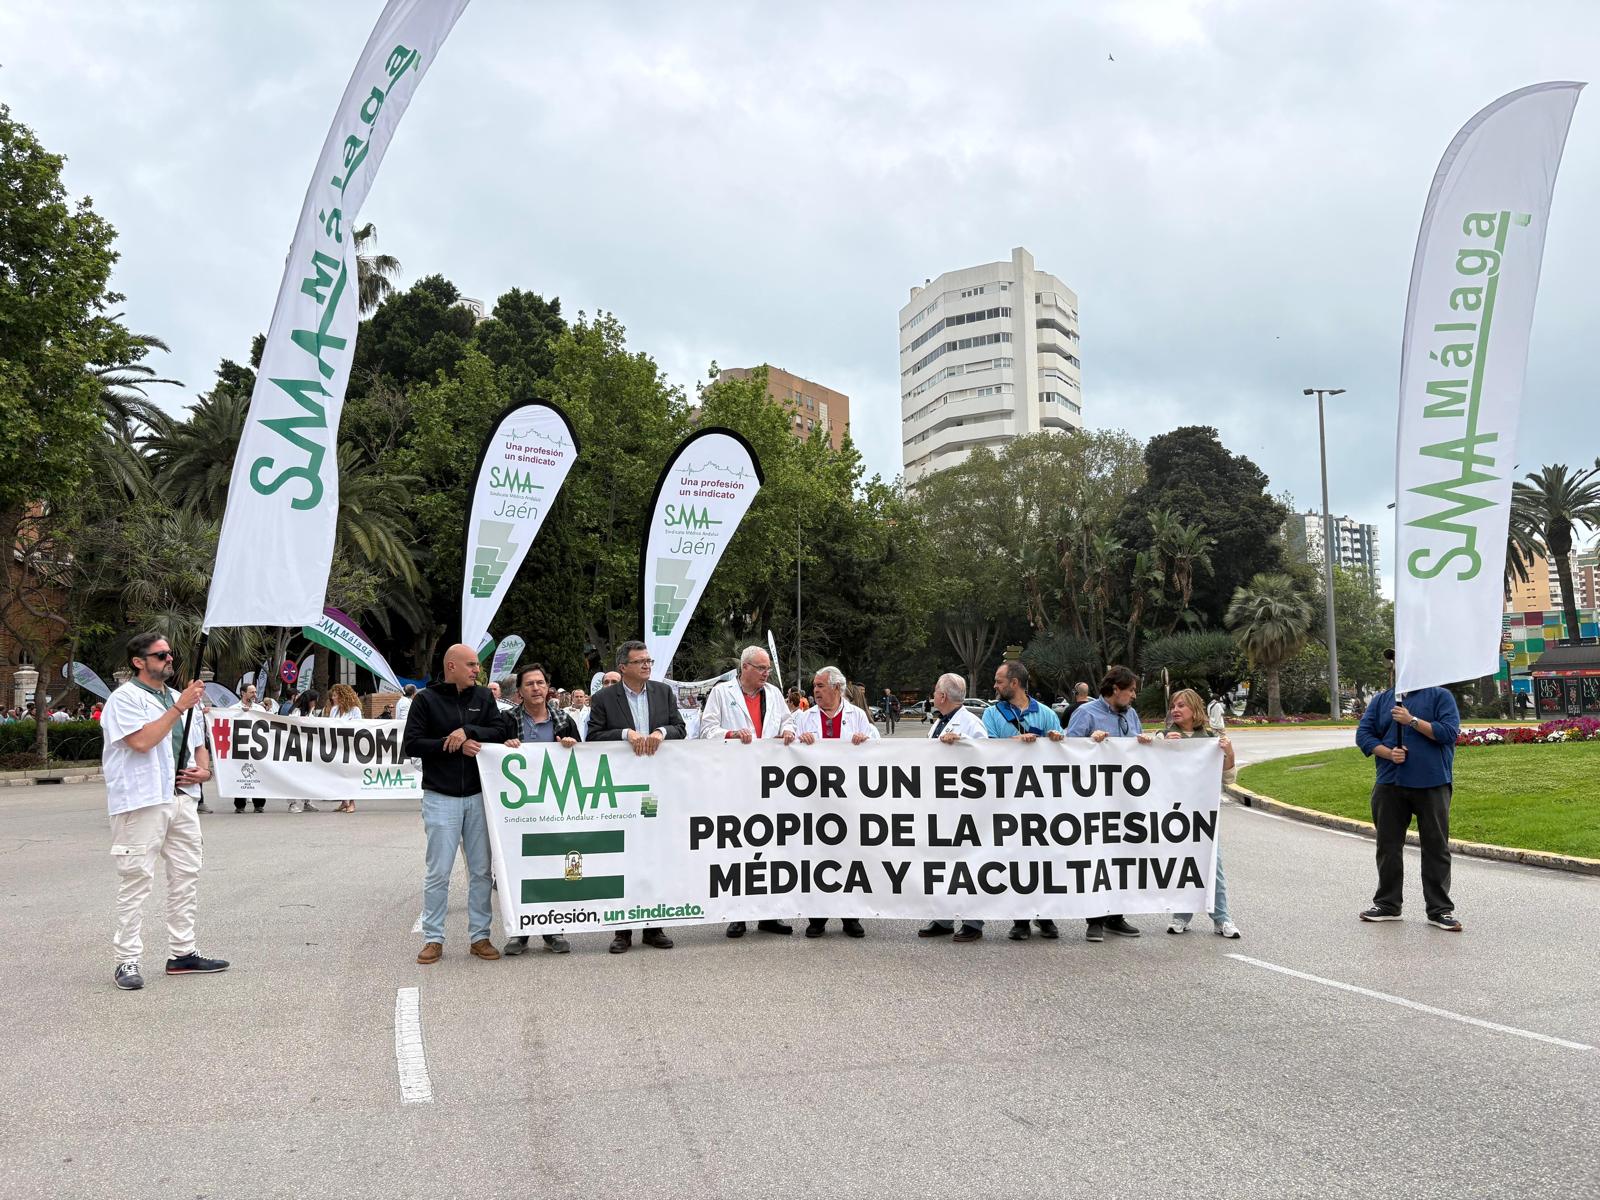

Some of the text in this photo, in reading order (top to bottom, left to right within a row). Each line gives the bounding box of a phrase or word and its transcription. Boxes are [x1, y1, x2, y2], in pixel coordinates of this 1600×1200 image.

[1403, 212, 1502, 581] SMA Málaga
[250, 329, 347, 511] SMA
[504, 453, 556, 467] un sindicato
[505, 442, 564, 458] Una profesión
[489, 466, 544, 494] SMA
[680, 477, 744, 490] Una profesión
[693, 489, 736, 500] sindicato
[493, 500, 538, 520] Jaén
[664, 503, 723, 530] SMA
[670, 537, 716, 555] Jaén
[363, 768, 414, 788] SMA
[500, 747, 650, 816] SMA
[761, 764, 1150, 799] POR UN ESTATUTO
[504, 815, 537, 823] Sindicato
[539, 814, 565, 823] Médico
[566, 814, 594, 822] Andaluz
[601, 812, 637, 820] Federación
[690, 802, 1217, 850] PROPIO DE LA PROFESIÓN
[709, 852, 1204, 898] MÉDICA Y FACULTATIVA
[520, 902, 705, 929] profesión, un sindicato.
